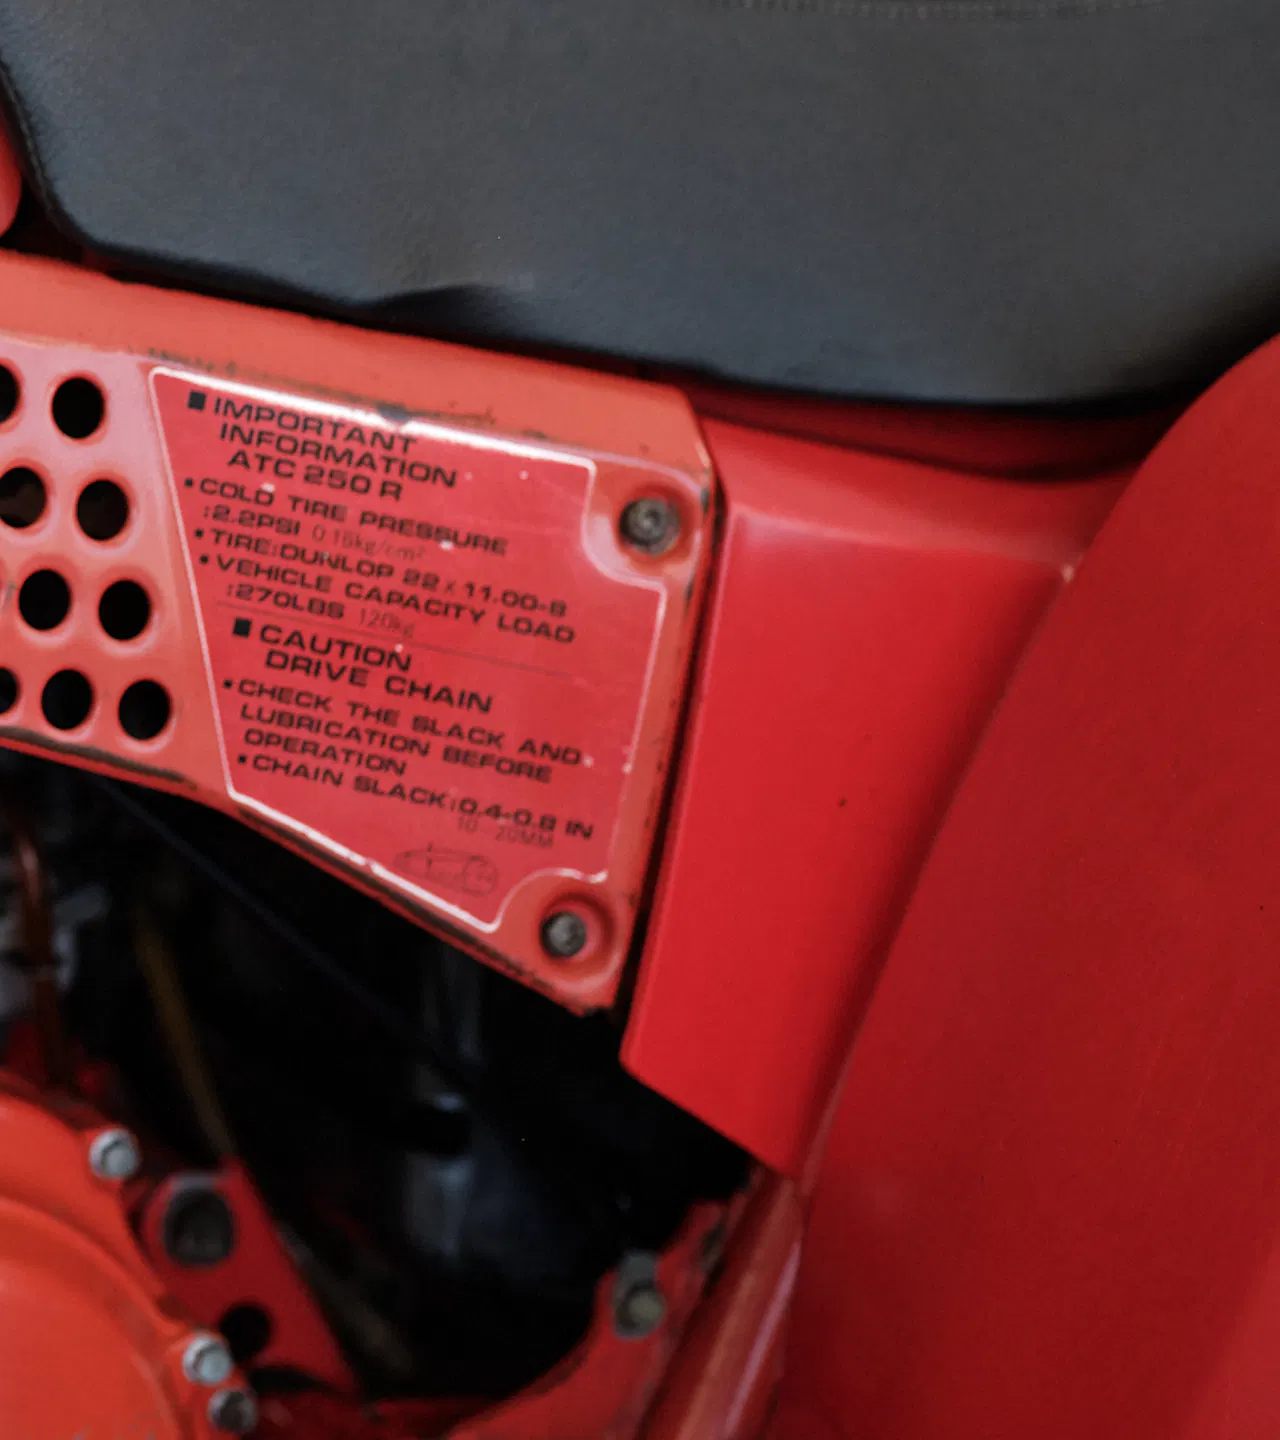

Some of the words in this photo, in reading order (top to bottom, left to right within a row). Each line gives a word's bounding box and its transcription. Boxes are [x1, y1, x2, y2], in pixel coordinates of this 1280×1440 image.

[214, 397, 416, 454] IMPORTANT
[220, 423, 457, 488] INFORMATION
[228, 450, 297, 479] ATC
[303, 464, 372, 495] 250
[379, 481, 403, 502] R
[199, 477, 276, 506] COLD
[288, 495, 348, 522] TIRE
[359, 509, 509, 555] PRESSURE
[216, 555, 333, 592] VEHICLE
[344, 581, 485, 623] CAPACITY
[496, 615, 576, 644] LOAD
[258, 623, 412, 671] CAUTION
[265, 650, 370, 687] DRIVE
[384, 675, 493, 713] CHAIN
[237, 678, 333, 712] CHECK
[347, 701, 401, 727] THE
[411, 715, 506, 748] SLACK
[517, 738, 583, 765] AND
[240, 703, 431, 757] LUBRICATION
[442, 745, 554, 783] BEFORE
[243, 728, 407, 776] OPERATION
[251, 754, 344, 787] CHAIN
[565, 818, 595, 841] IN
